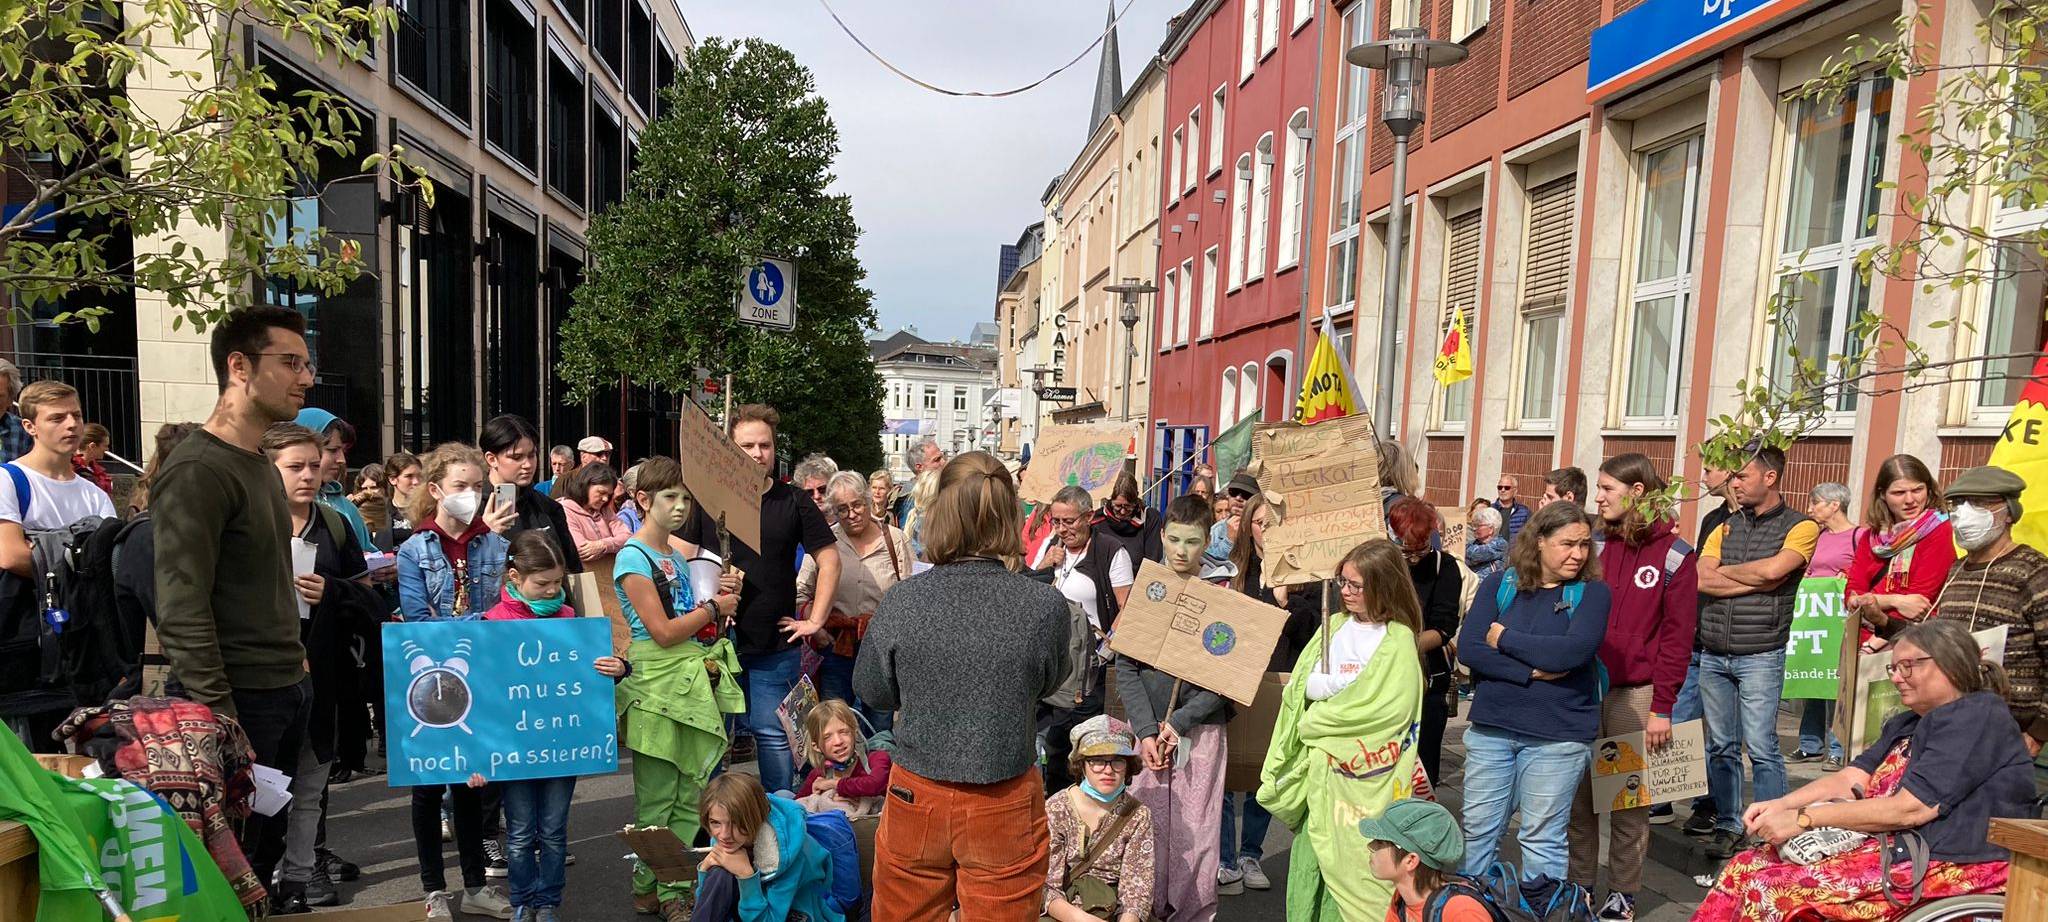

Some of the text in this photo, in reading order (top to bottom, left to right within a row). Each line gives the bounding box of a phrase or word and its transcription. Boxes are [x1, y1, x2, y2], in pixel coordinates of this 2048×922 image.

[752, 306, 778, 320] ZONE
[517, 639, 579, 667] Was
[1785, 668, 1824, 679] bände
[509, 681, 583, 700] muss
[515, 710, 581, 731] denn
[410, 734, 615, 777] noch passieren?
[1675, 765, 1691, 776] DIE
